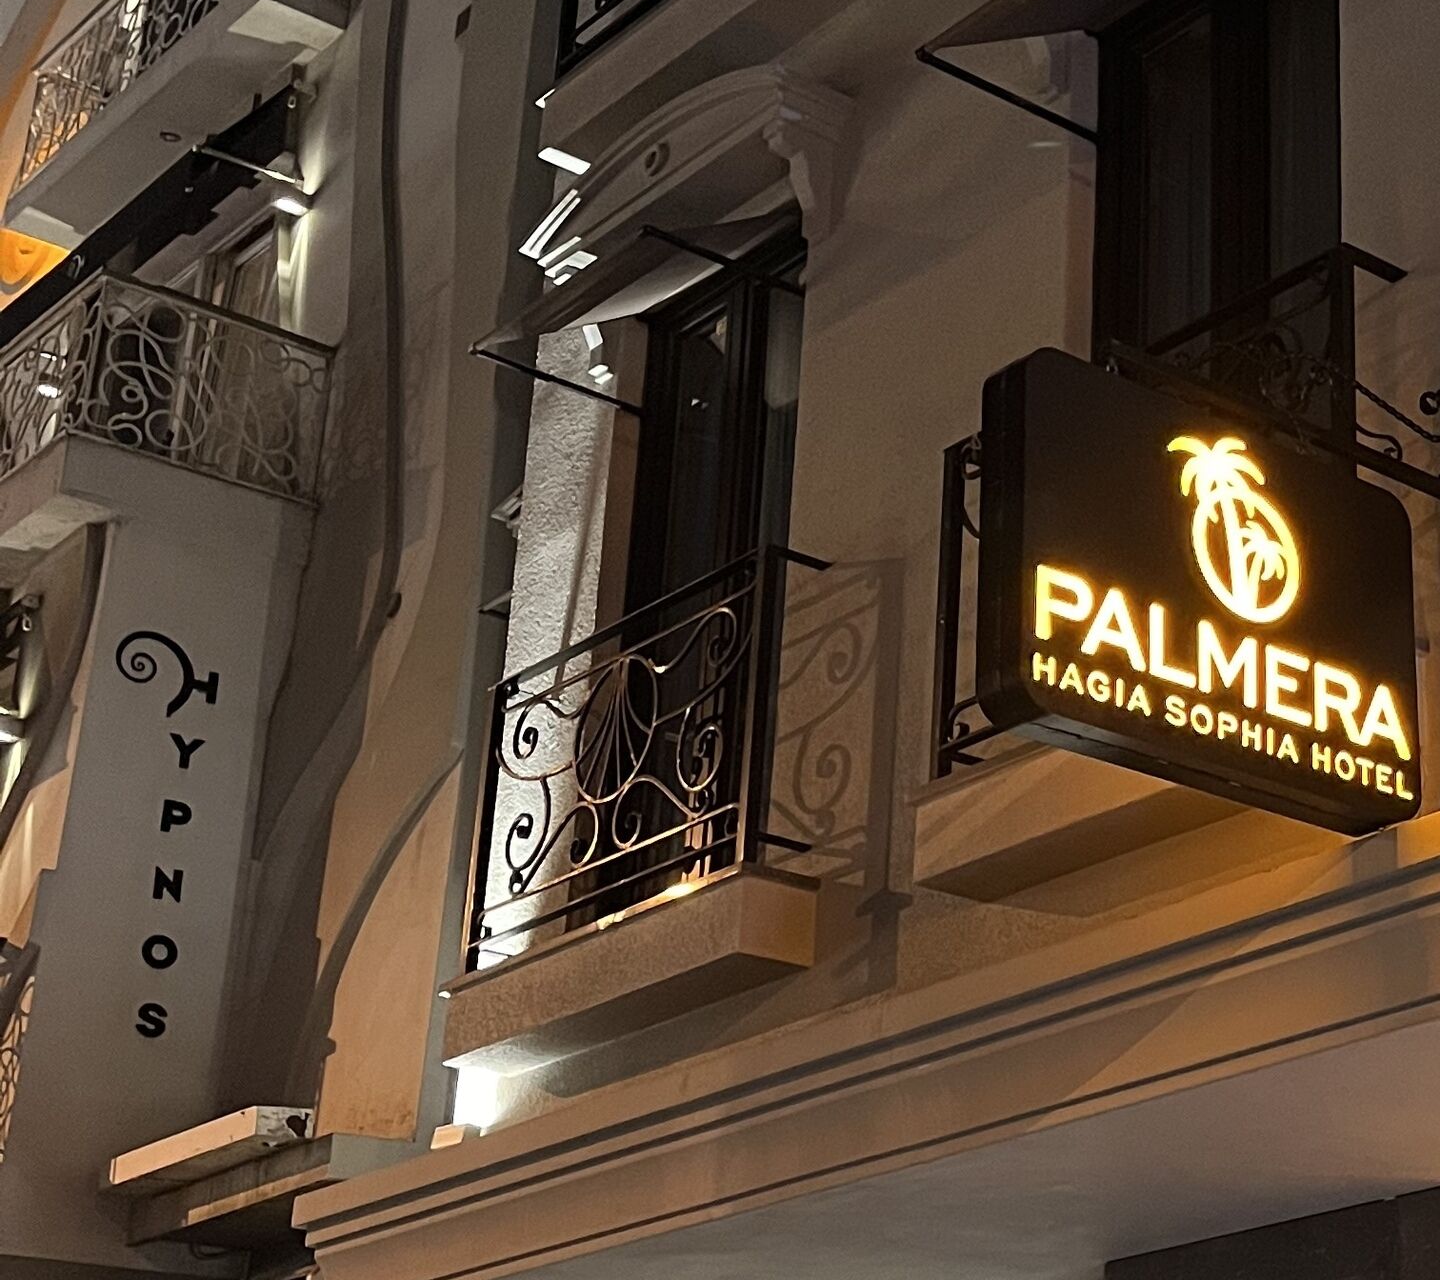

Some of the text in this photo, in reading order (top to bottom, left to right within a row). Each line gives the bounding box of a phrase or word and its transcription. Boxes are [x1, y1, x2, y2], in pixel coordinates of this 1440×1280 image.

[1032, 653, 1414, 800] HAGIA SOPHIA HOTEL
[1034, 565, 1411, 760] PALMERA
[116, 631, 219, 1038] HYPNOS
